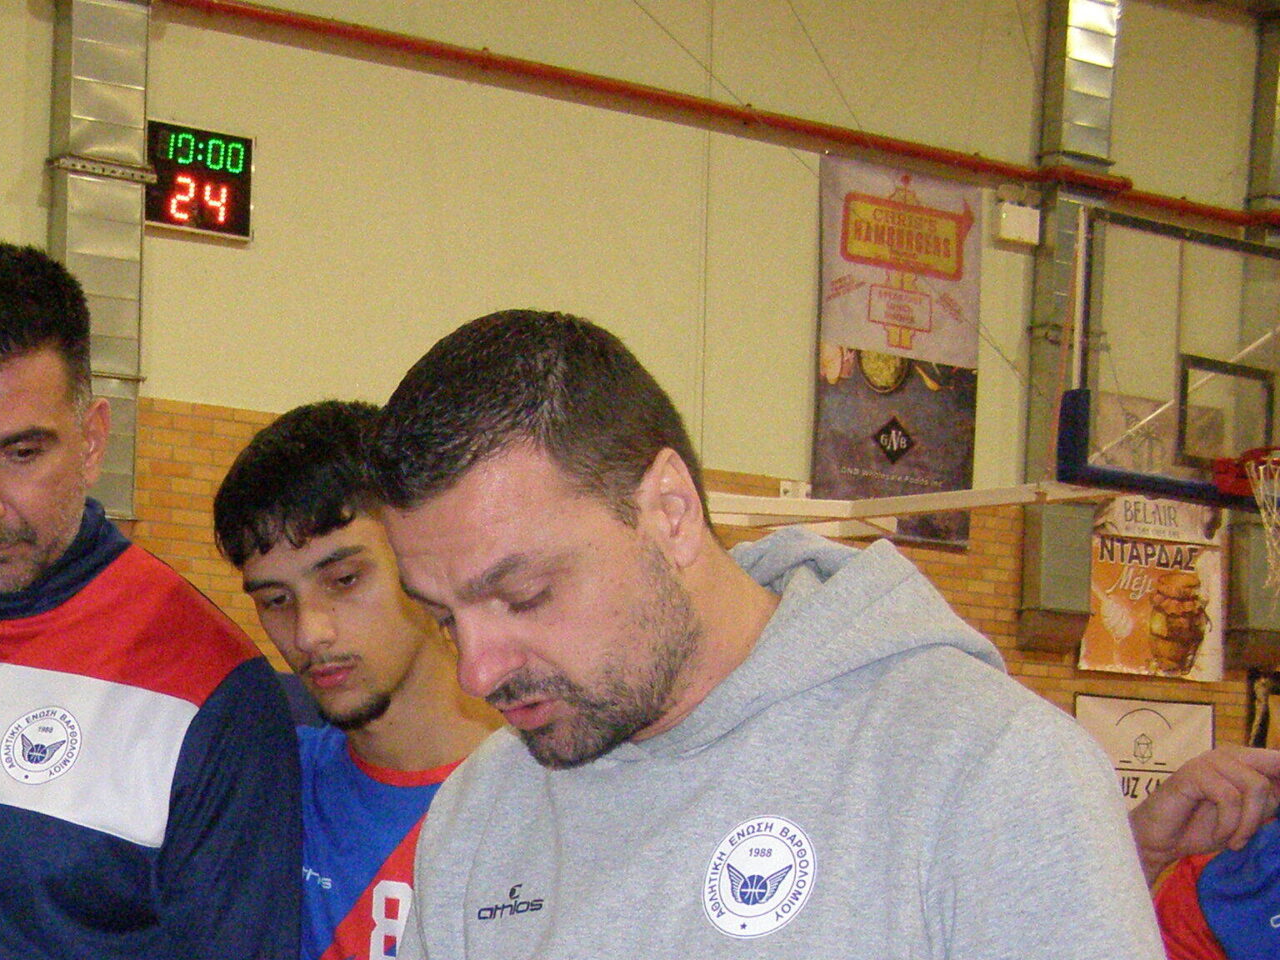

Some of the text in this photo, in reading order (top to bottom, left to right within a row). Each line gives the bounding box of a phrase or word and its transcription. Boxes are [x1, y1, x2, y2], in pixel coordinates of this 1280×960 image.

[170, 175, 227, 222] 24
[853, 218, 952, 259] HAMBURGERS
[25, 709, 58, 724] ΕΝΩΣΗ
[708, 822, 810, 922] ΑΘΛΗΤΙΚΗ ΕΝΩΣΗ ΒΑΡΘΟΛΟΜΙΟΥ
[748, 847, 773, 858] 1988
